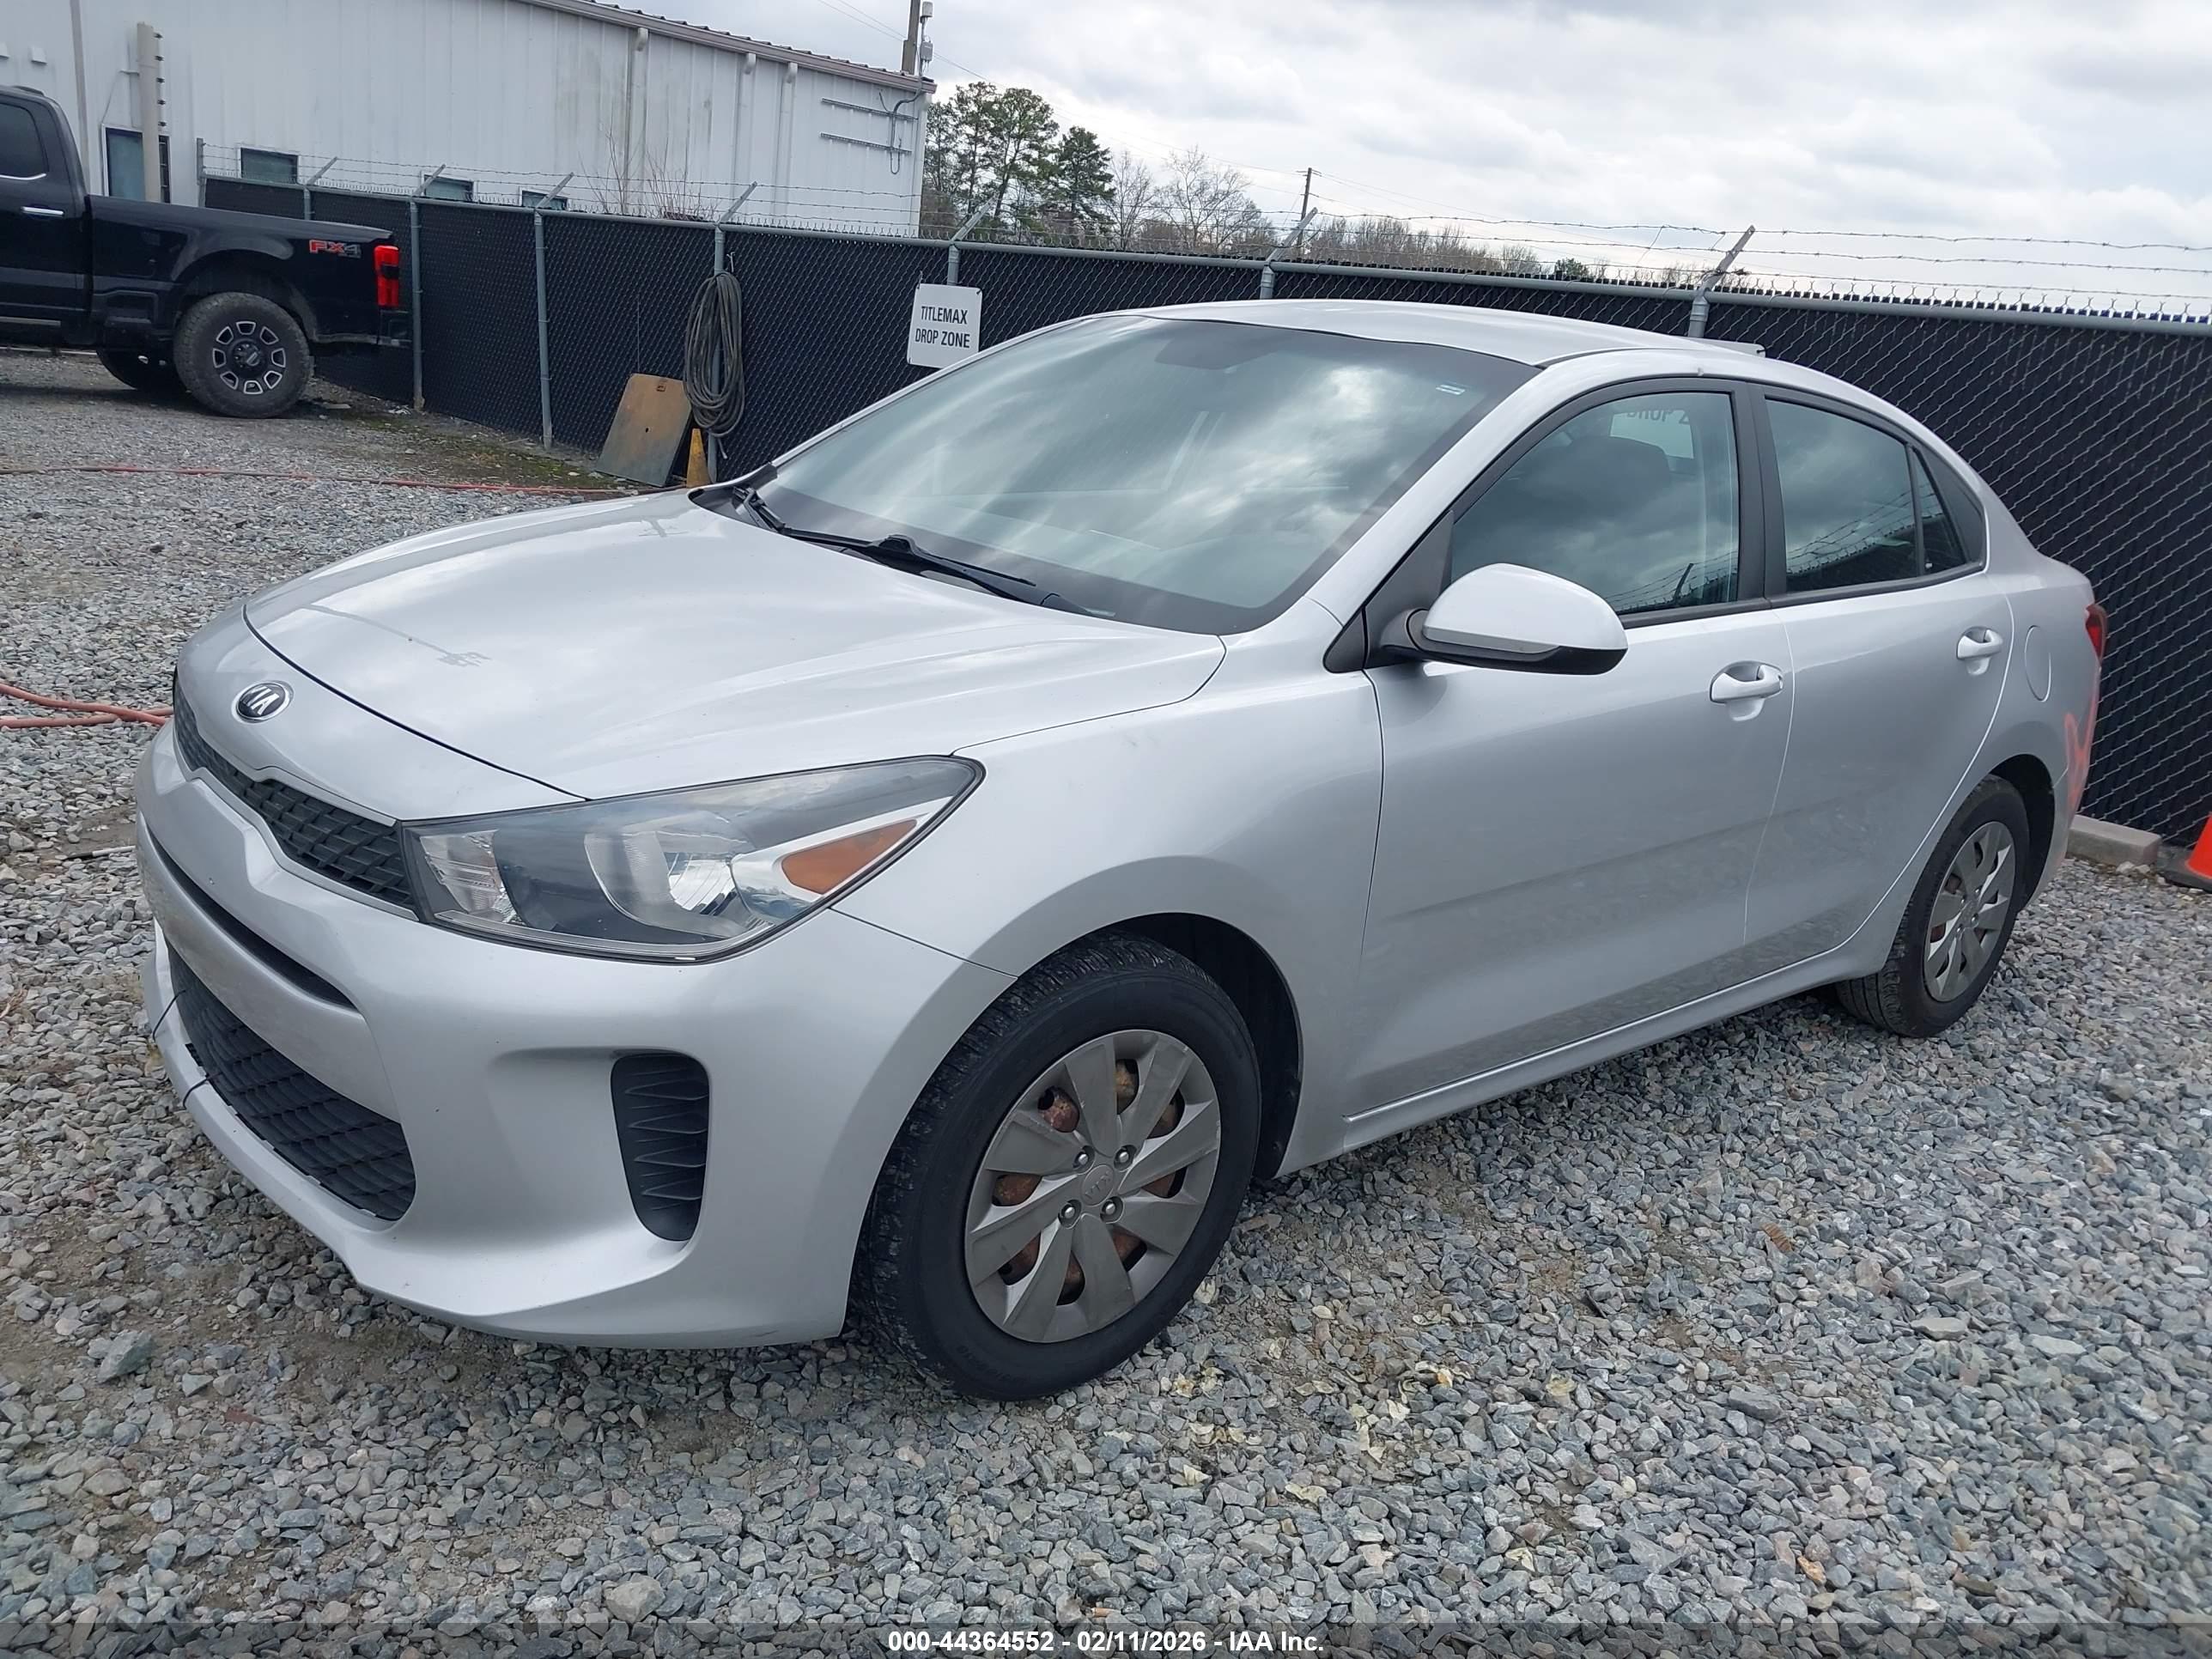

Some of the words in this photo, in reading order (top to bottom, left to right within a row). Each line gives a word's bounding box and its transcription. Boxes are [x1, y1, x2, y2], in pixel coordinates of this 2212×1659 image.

[309, 240, 361, 257] FX4
[921, 306, 968, 325] TITLEMAX
[915, 328, 939, 344] DROP
[941, 331, 970, 349] ZONE
